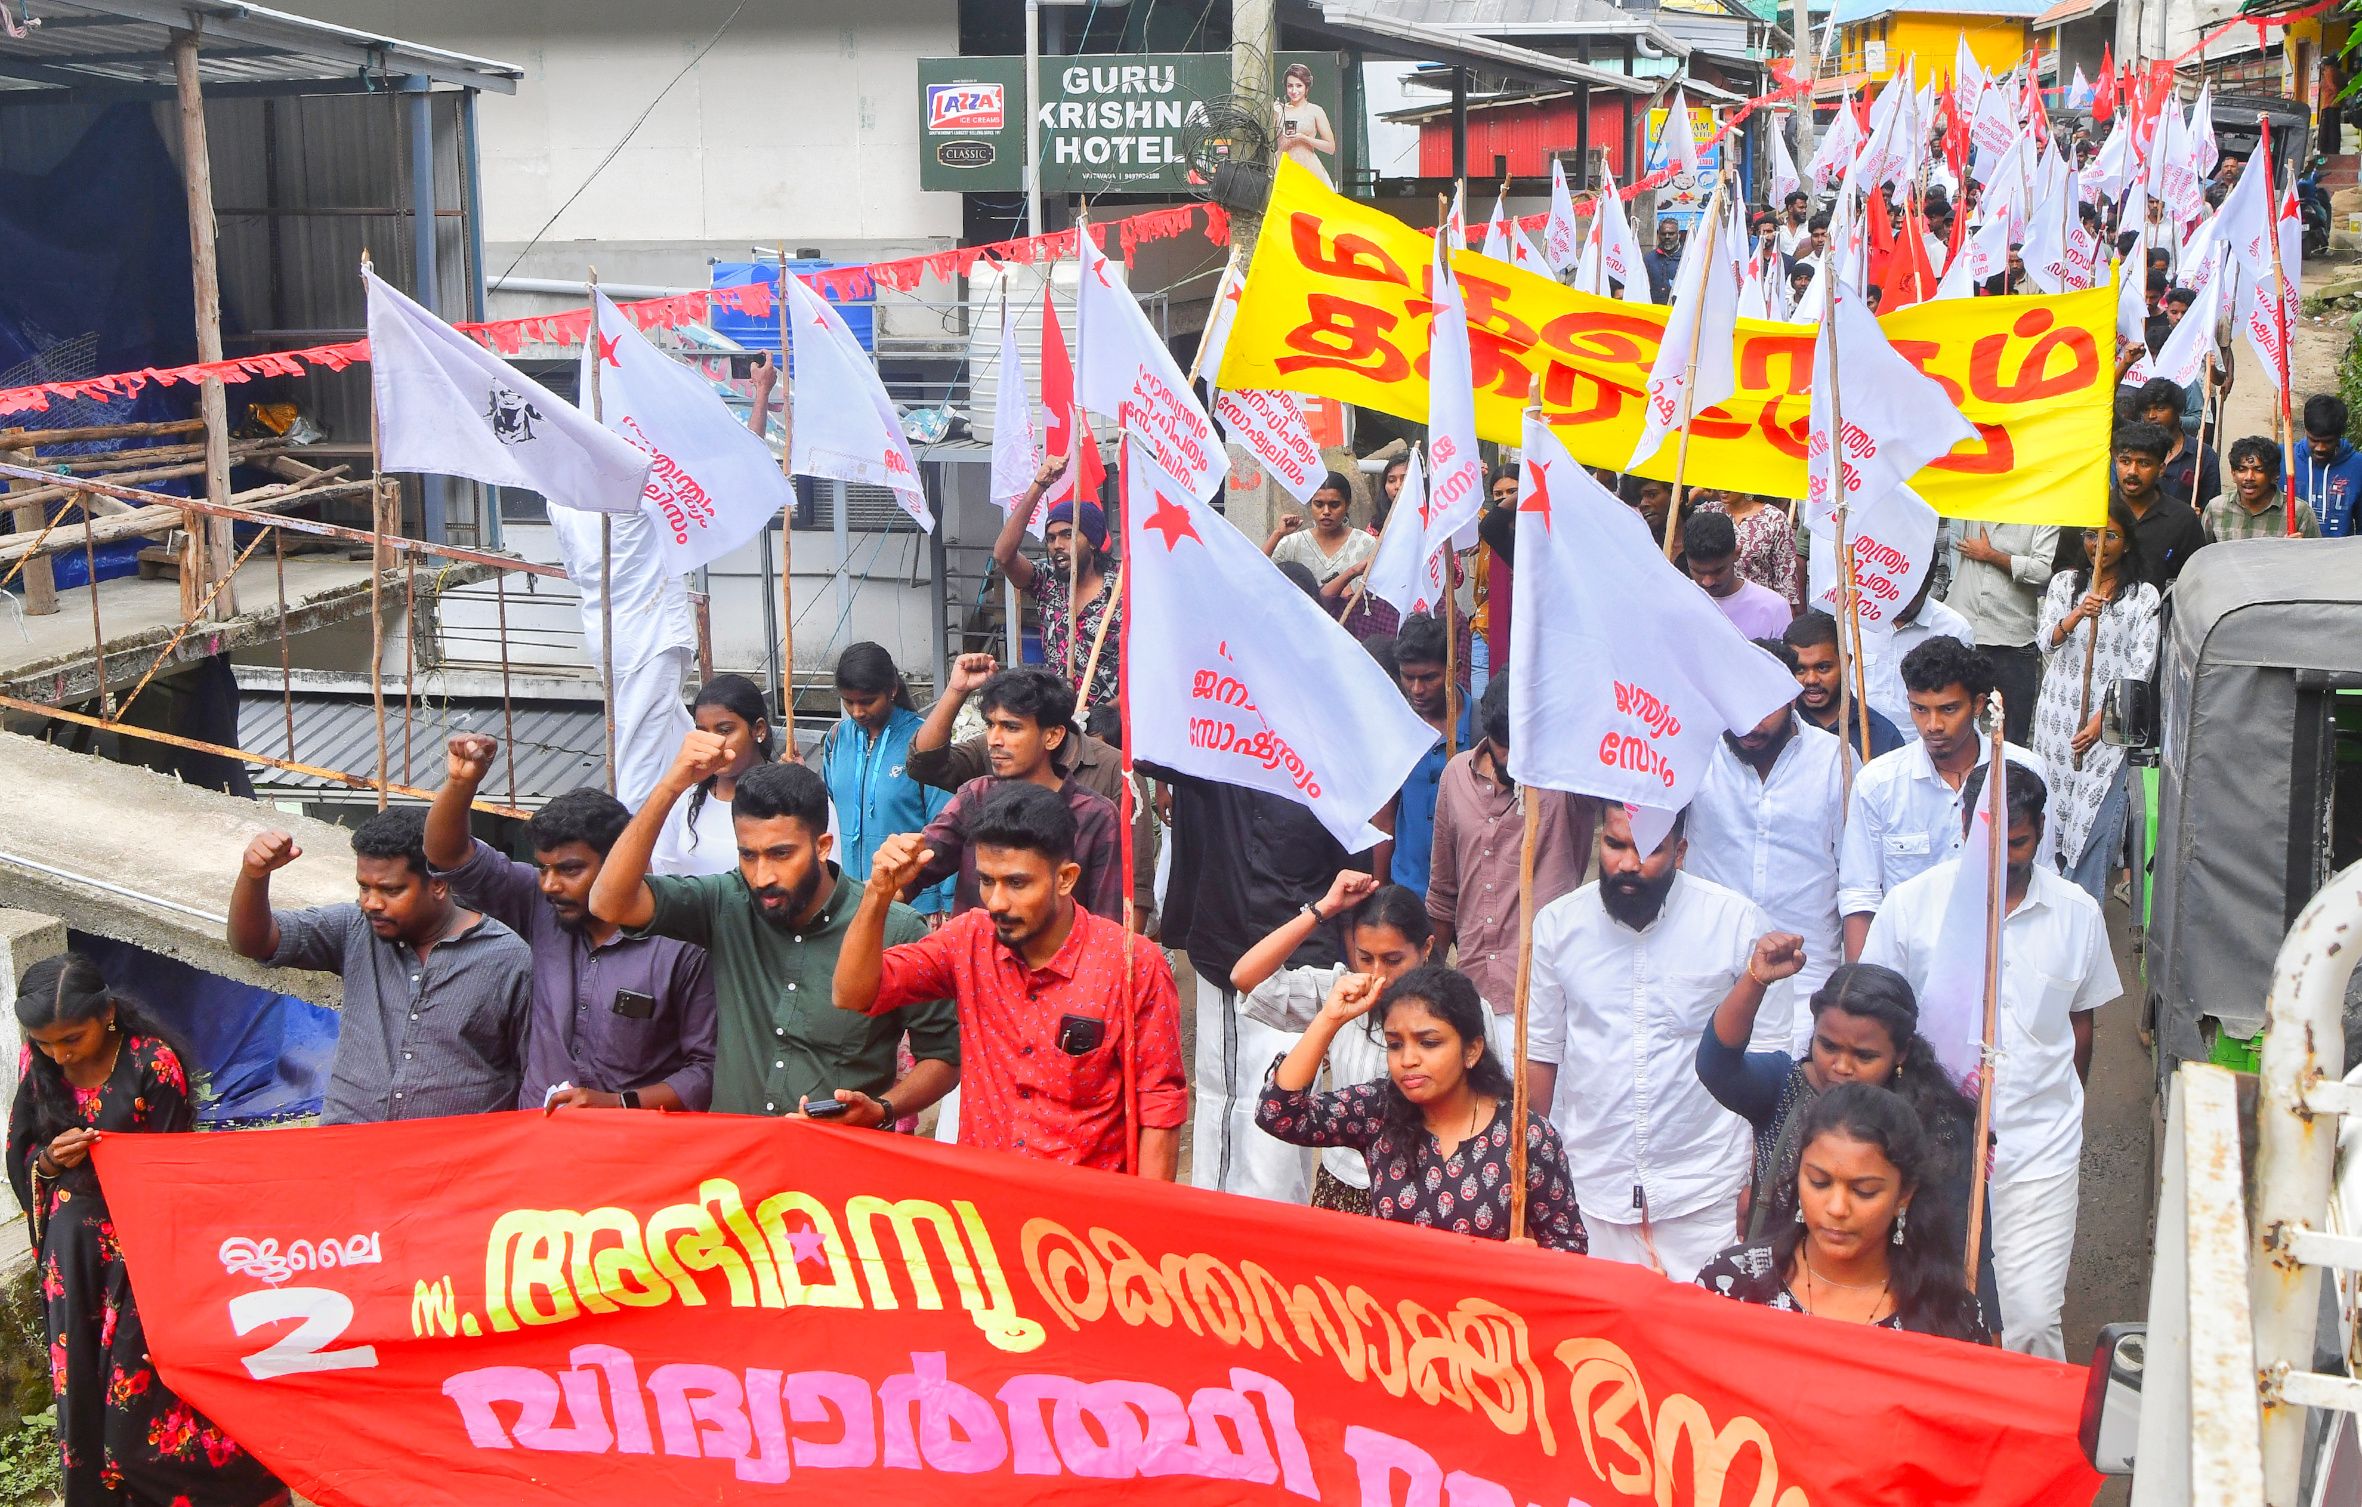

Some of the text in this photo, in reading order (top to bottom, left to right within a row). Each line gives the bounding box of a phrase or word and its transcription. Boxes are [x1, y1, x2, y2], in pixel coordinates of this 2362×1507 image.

[1063, 65, 1175, 94] GURU
[934, 93, 994, 121] LAZZA
[1039, 101, 1211, 129] KRISHNA
[946, 149, 987, 158] CLASSIC
[1055, 136, 1185, 164] HOTEL
[229, 1286, 380, 1380] 2
